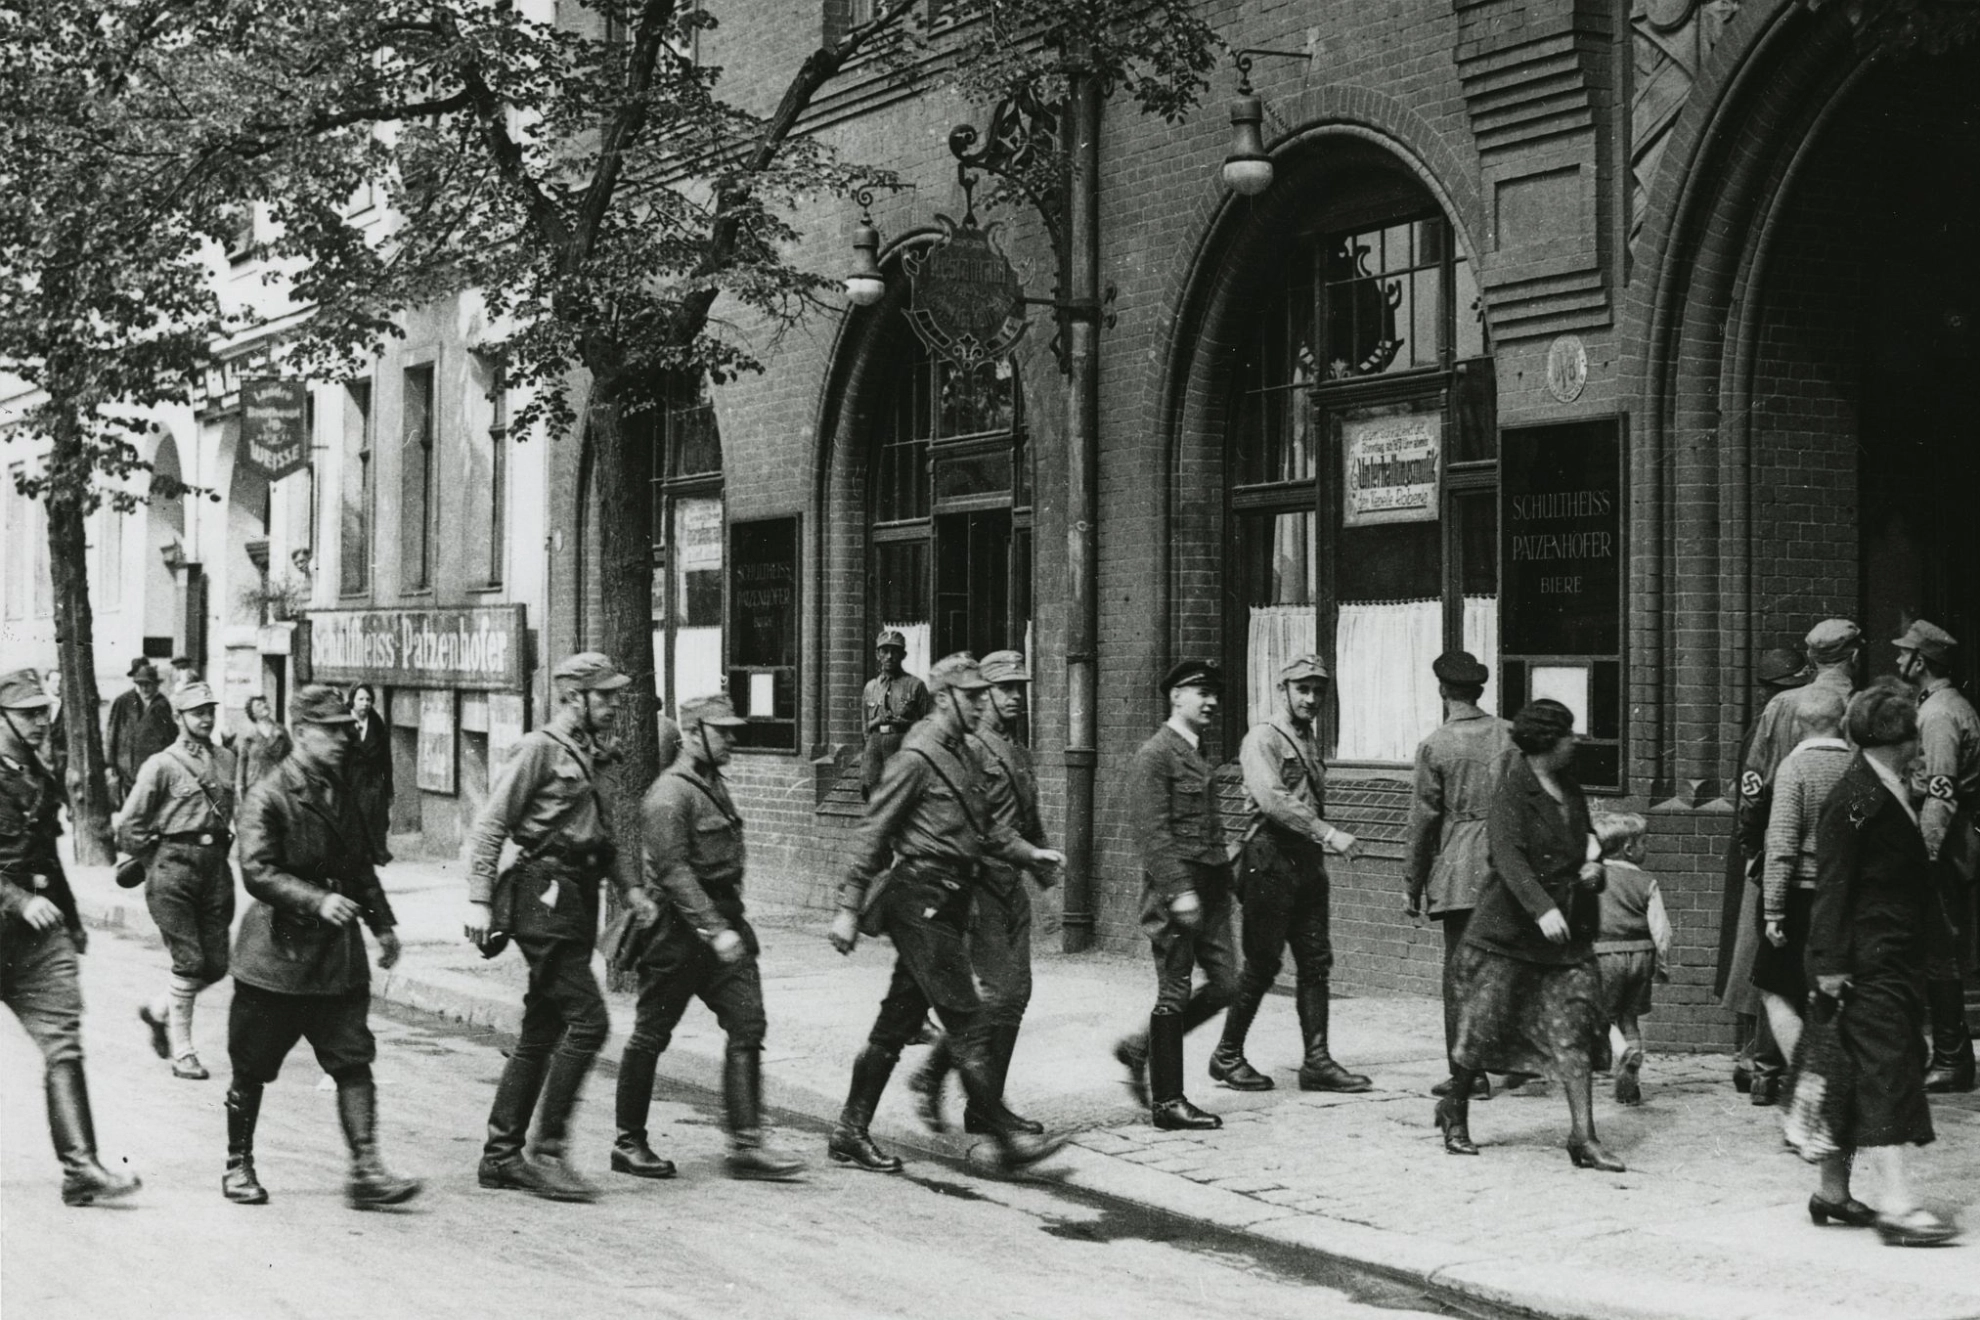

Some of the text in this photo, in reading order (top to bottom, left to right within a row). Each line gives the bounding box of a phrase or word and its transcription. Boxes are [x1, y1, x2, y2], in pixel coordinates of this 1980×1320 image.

[249, 439, 299, 471] WEISSE
[1512, 489, 1611, 520] SCHULTHEISS
[1512, 531, 1612, 561] PATZENHOFER
[1541, 576, 1582, 594] BIERE
